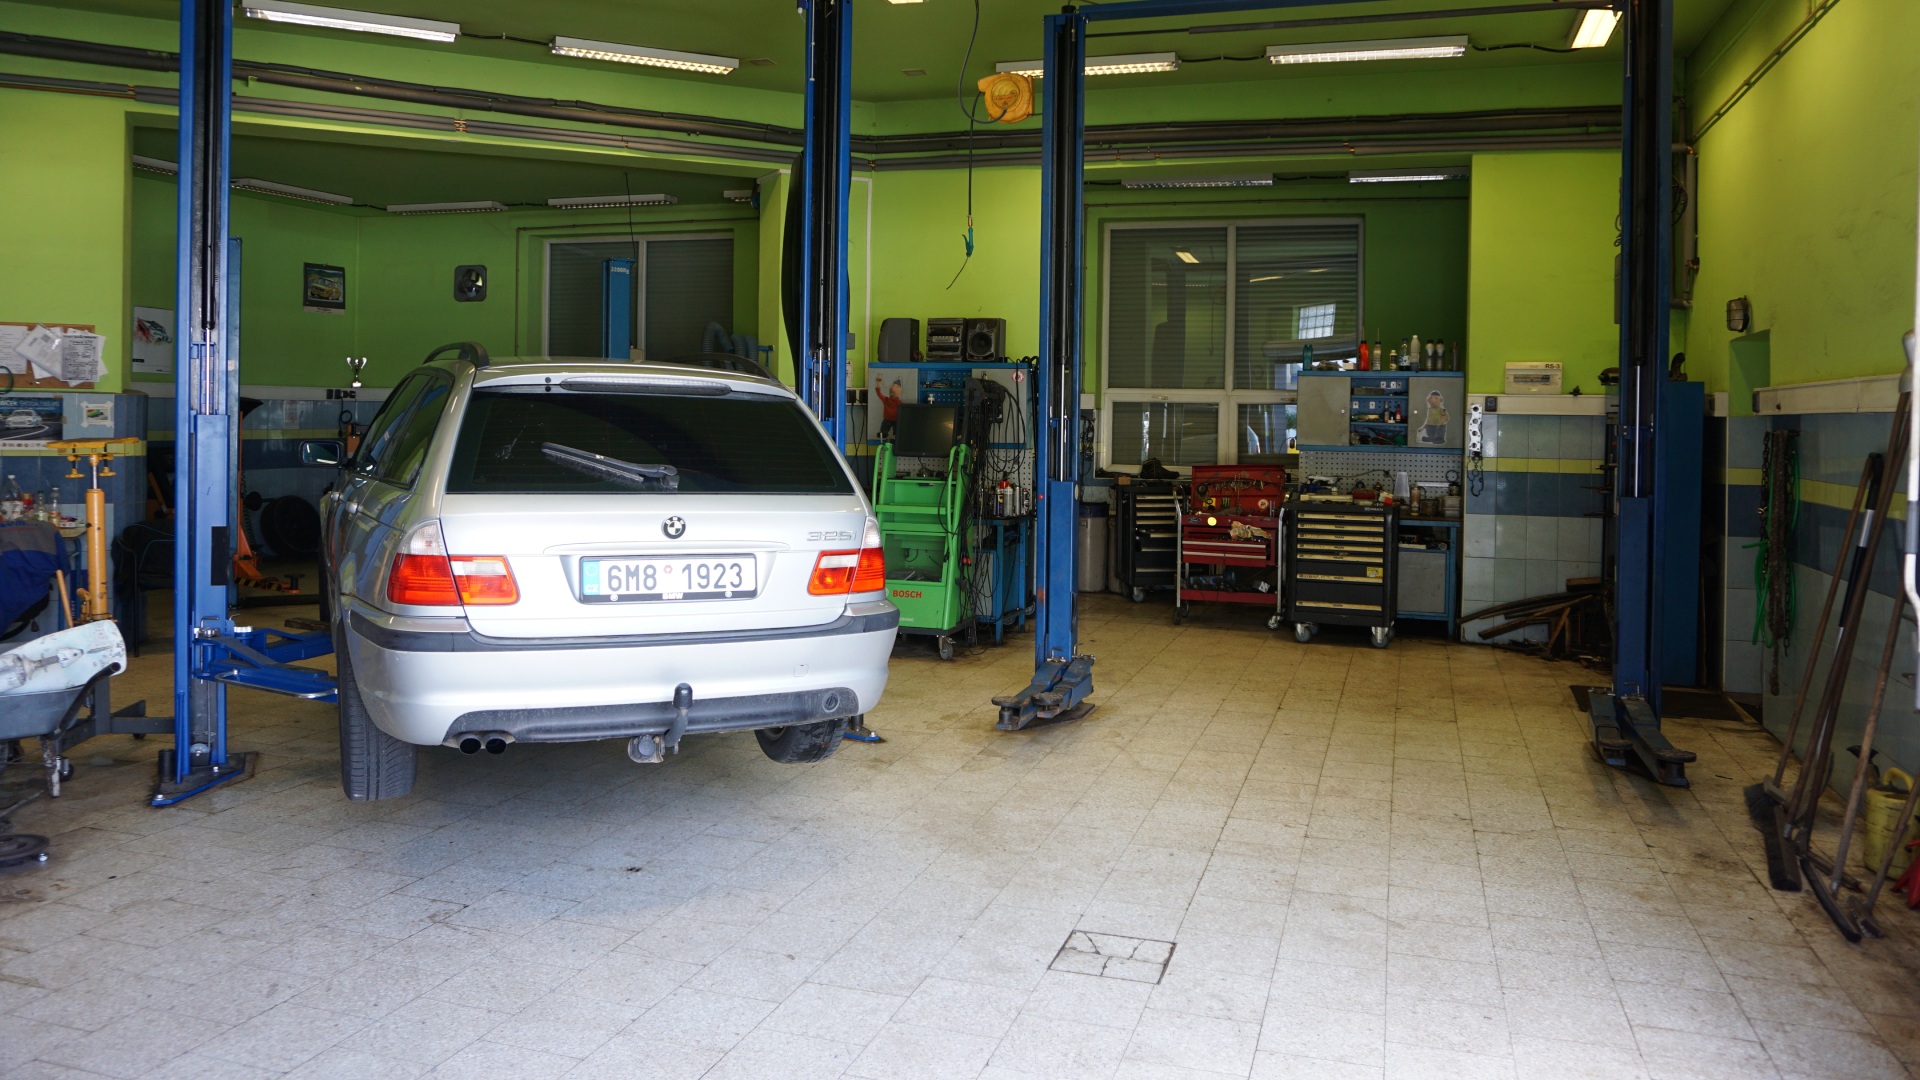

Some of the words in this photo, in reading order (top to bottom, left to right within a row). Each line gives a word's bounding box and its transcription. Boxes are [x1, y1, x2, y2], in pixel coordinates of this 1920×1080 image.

[807, 531, 857, 541] 325i
[607, 564, 657, 592] 6M8
[682, 562, 743, 590] 1923
[585, 583, 599, 593] CZ
[662, 592, 684, 600] BMW
[892, 589, 922, 599] BOSCH
